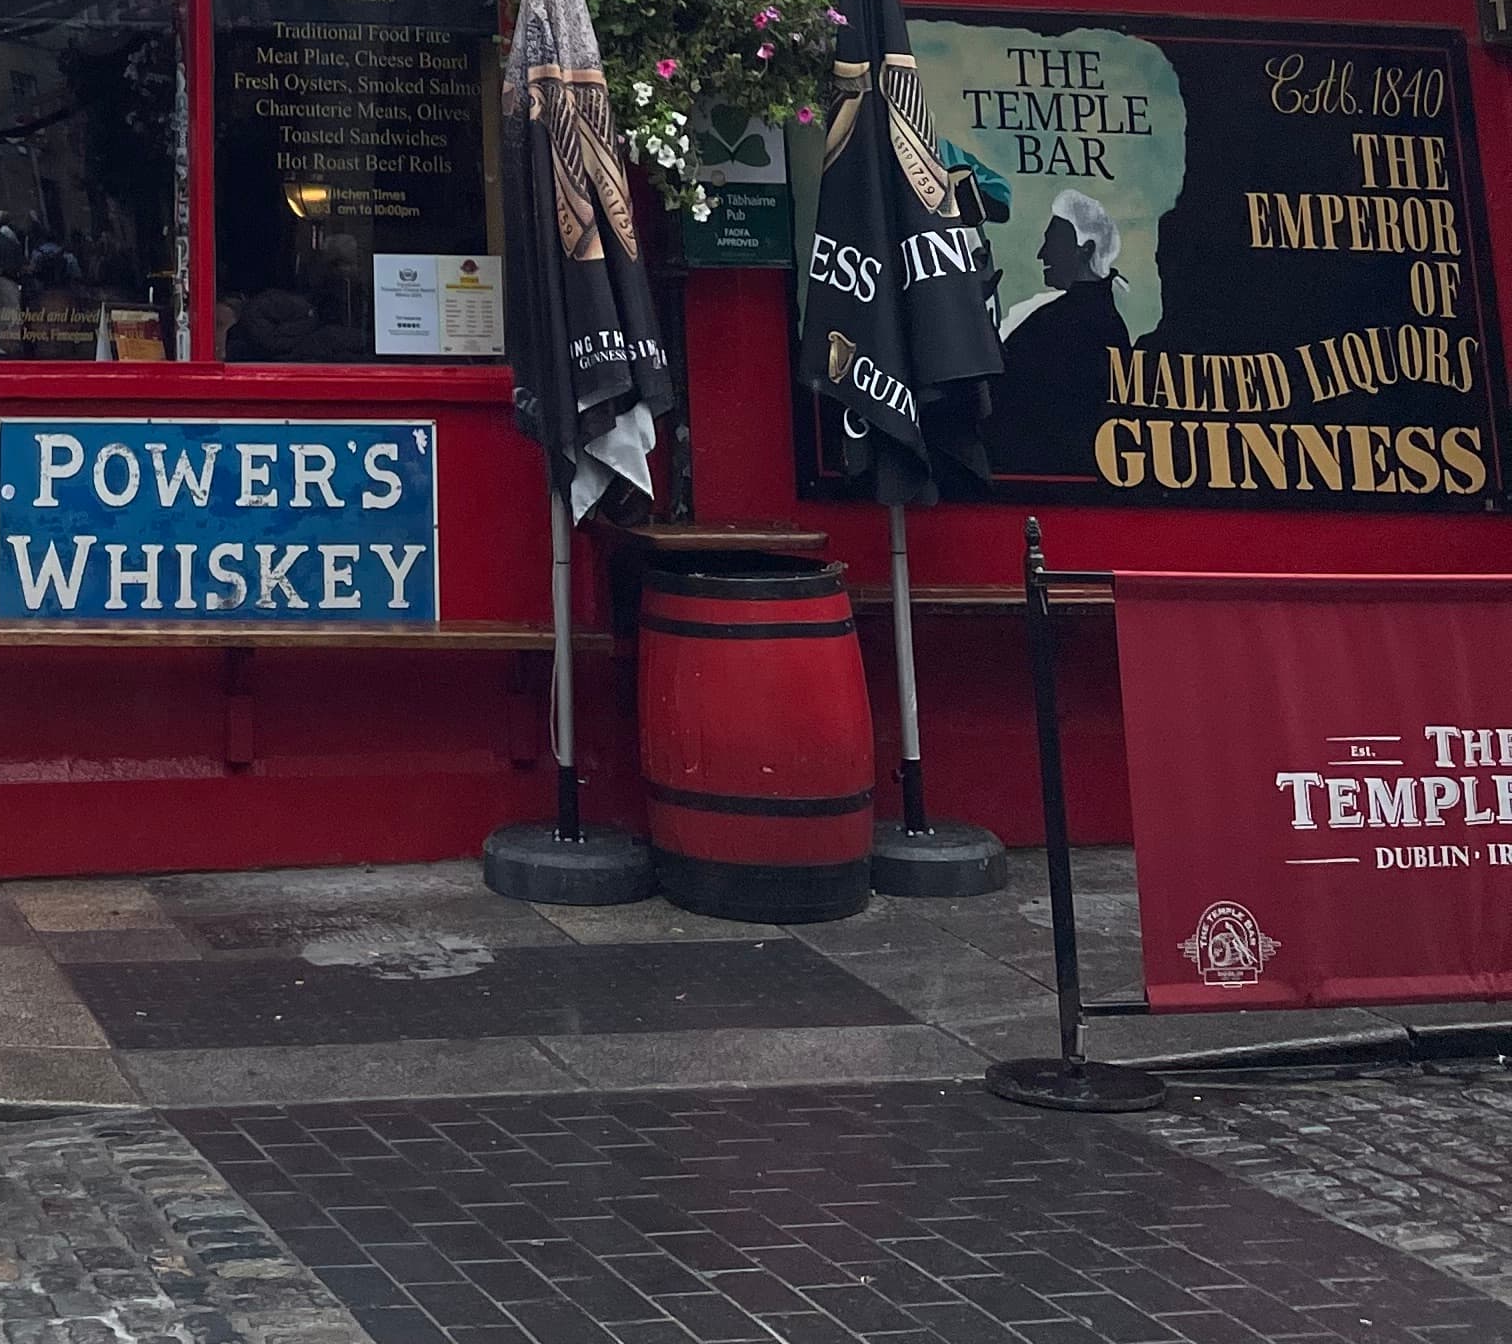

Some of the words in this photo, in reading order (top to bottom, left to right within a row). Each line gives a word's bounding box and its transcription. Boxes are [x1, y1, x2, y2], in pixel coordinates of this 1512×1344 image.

[274, 21, 363, 41] Traditional
[368, 25, 410, 43] Food
[415, 27, 450, 44] Fare
[256, 47, 298, 65] Meat
[304, 48, 349, 67] Plate,
[355, 50, 413, 69] Cheese
[419, 52, 468, 70] Board
[1007, 47, 1105, 90] THE
[234, 72, 279, 90] Fresh
[284, 74, 352, 95] Oysters,
[358, 76, 424, 95] Smoked
[1373, 66, 1445, 118] 1840
[255, 98, 352, 119] Charcuterie
[357, 102, 413, 123] Meats,
[417, 104, 470, 122] Olives
[962, 89, 1153, 135] TEMPLE
[280, 125, 344, 145] Toasted
[349, 128, 448, 147] Sandwiches
[276, 152, 308, 170] Hot
[314, 153, 360, 172] Roast
[365, 155, 405, 173] Beef
[409, 156, 453, 174] Rolls
[1016, 135, 1115, 181] BAR
[1352, 133, 1450, 191] THE
[909, 162, 936, 195] 1759
[727, 209, 747, 222] Pub
[1244, 191, 1462, 256] EMPEROR
[717, 238, 760, 248] APPROVED
[1410, 261, 1461, 319] OF
[1106, 346, 1291, 412] MALTED
[1295, 323, 1480, 404] LIQUORS
[32, 433, 403, 509] POWER'S
[1094, 418, 1487, 495] GUINNESS
[6, 535, 426, 610] WHISKEY
[1351, 745, 1377, 758] Est.
[1375, 844, 1471, 870] DUBLIN
